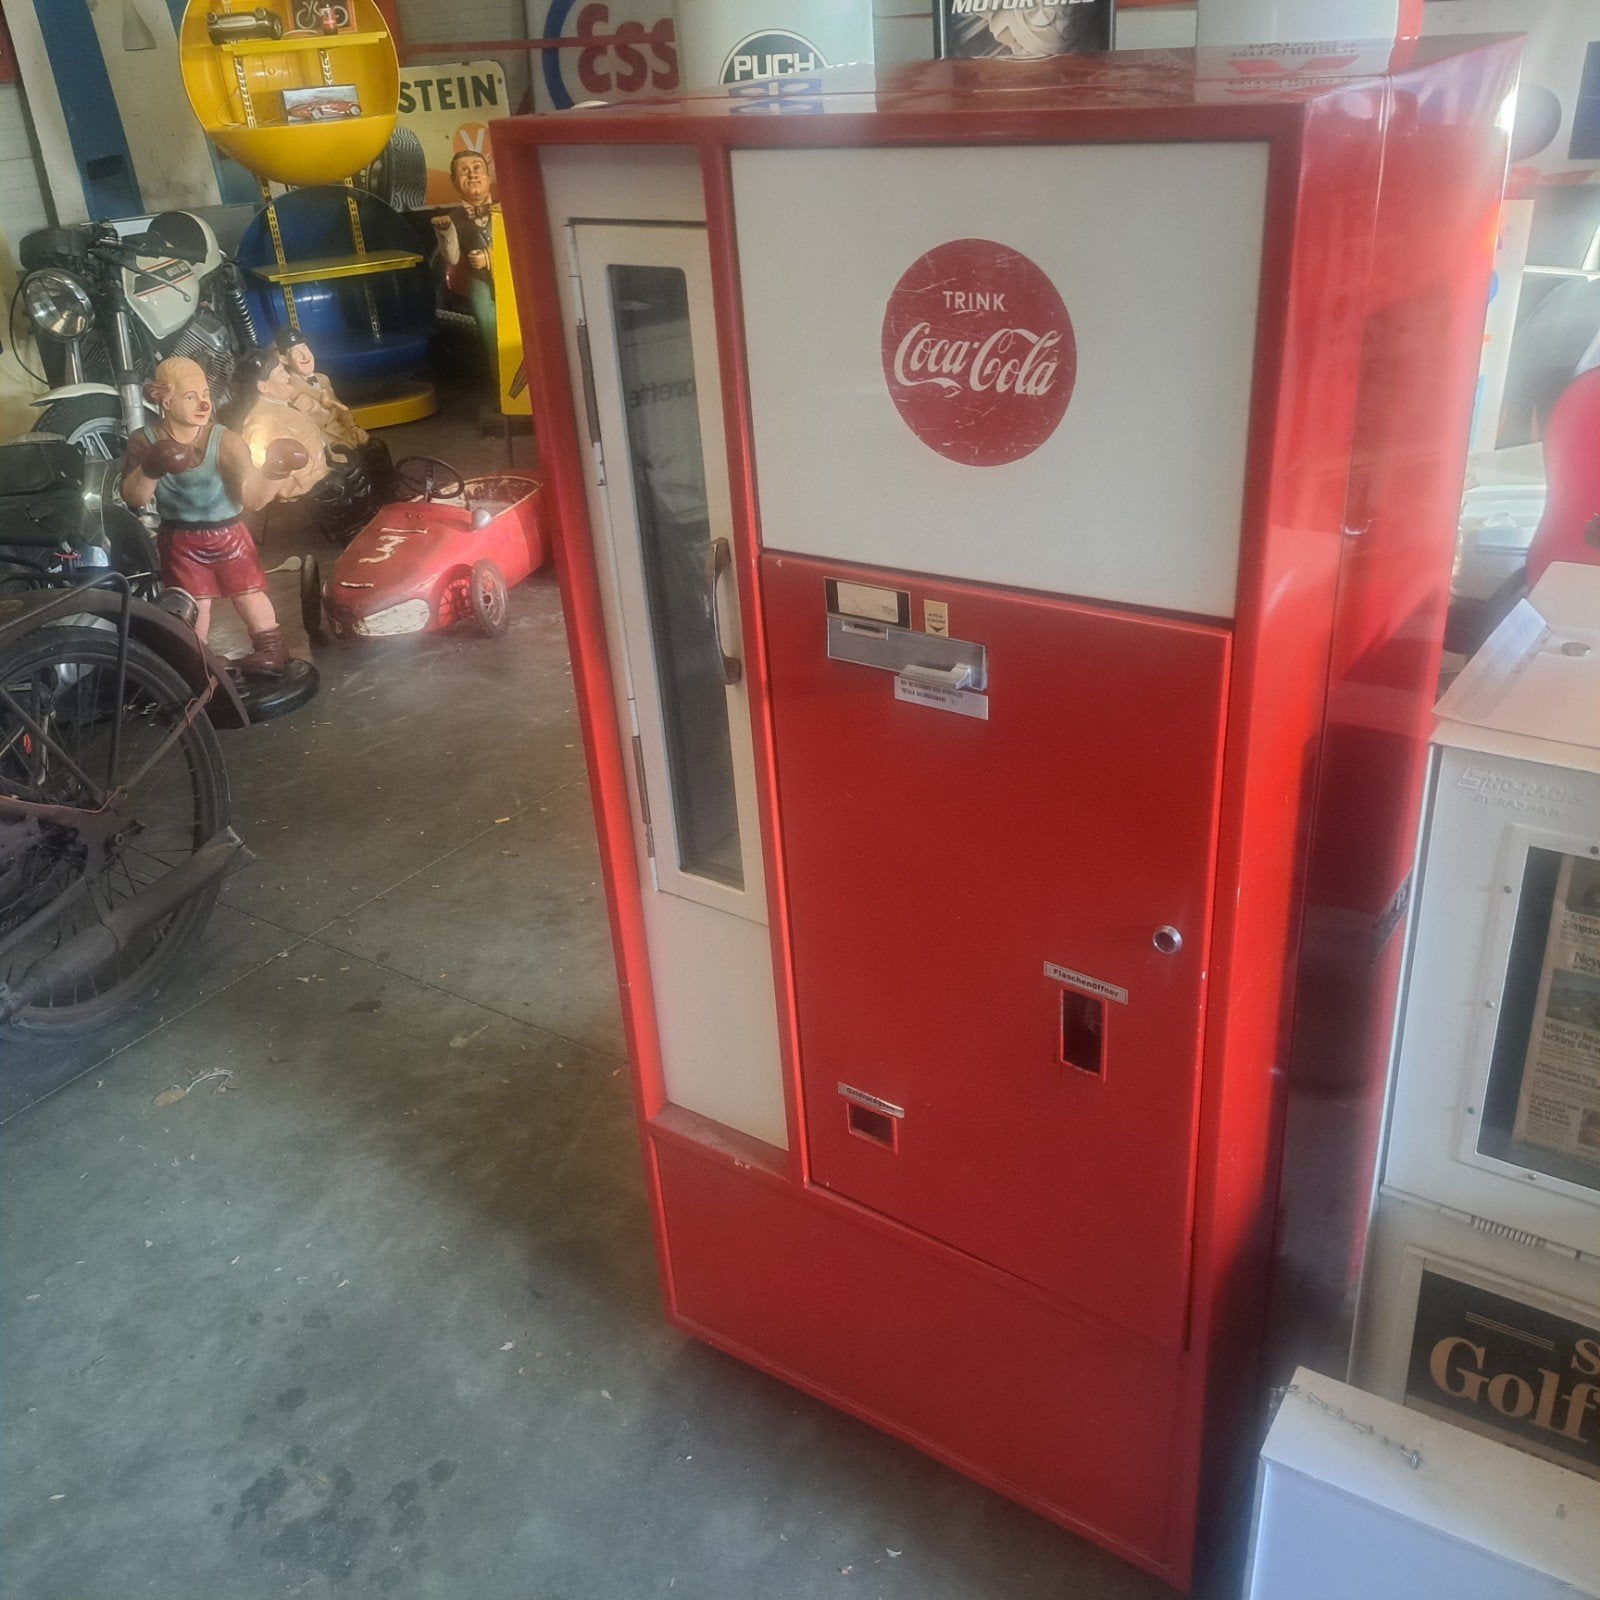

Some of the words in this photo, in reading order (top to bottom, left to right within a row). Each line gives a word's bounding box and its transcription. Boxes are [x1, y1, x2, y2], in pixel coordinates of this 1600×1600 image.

[733, 51, 815, 81] PUCH
[398, 73, 499, 114] STEIN
[942, 291, 1007, 312] TRINK
[893, 321, 1063, 398] Coca-Cola
[1053, 968, 1119, 997] Flaschenöffner
[1429, 1335, 1600, 1443] Golf
